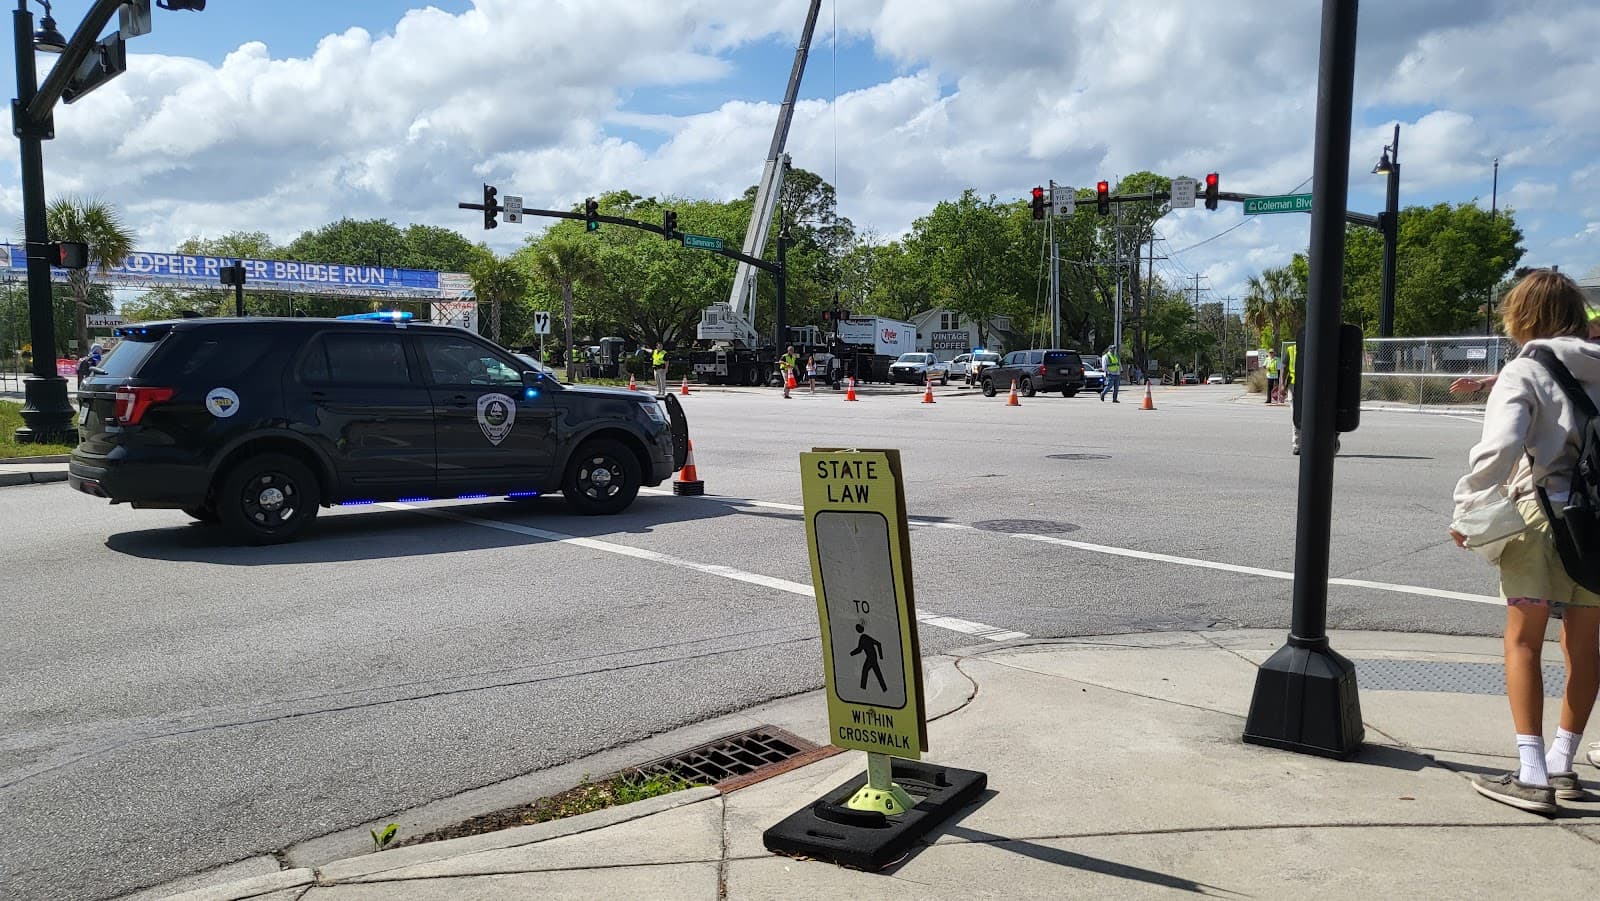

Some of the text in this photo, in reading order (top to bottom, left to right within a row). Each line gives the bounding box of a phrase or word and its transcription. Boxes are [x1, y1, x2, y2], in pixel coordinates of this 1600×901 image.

[1257, 200, 1293, 211] Coleman
[715, 240, 722, 249] St
[109, 252, 198, 275] OOPER
[274, 261, 340, 282] BRIDGE
[344, 266, 385, 284] RUN
[933, 333, 968, 341] VINTAGE
[817, 460, 878, 480] STATE
[827, 484, 869, 504] LAW
[853, 600, 870, 614] TO
[852, 710, 894, 729] WITHIN
[839, 726, 911, 750] CROSSWALK
